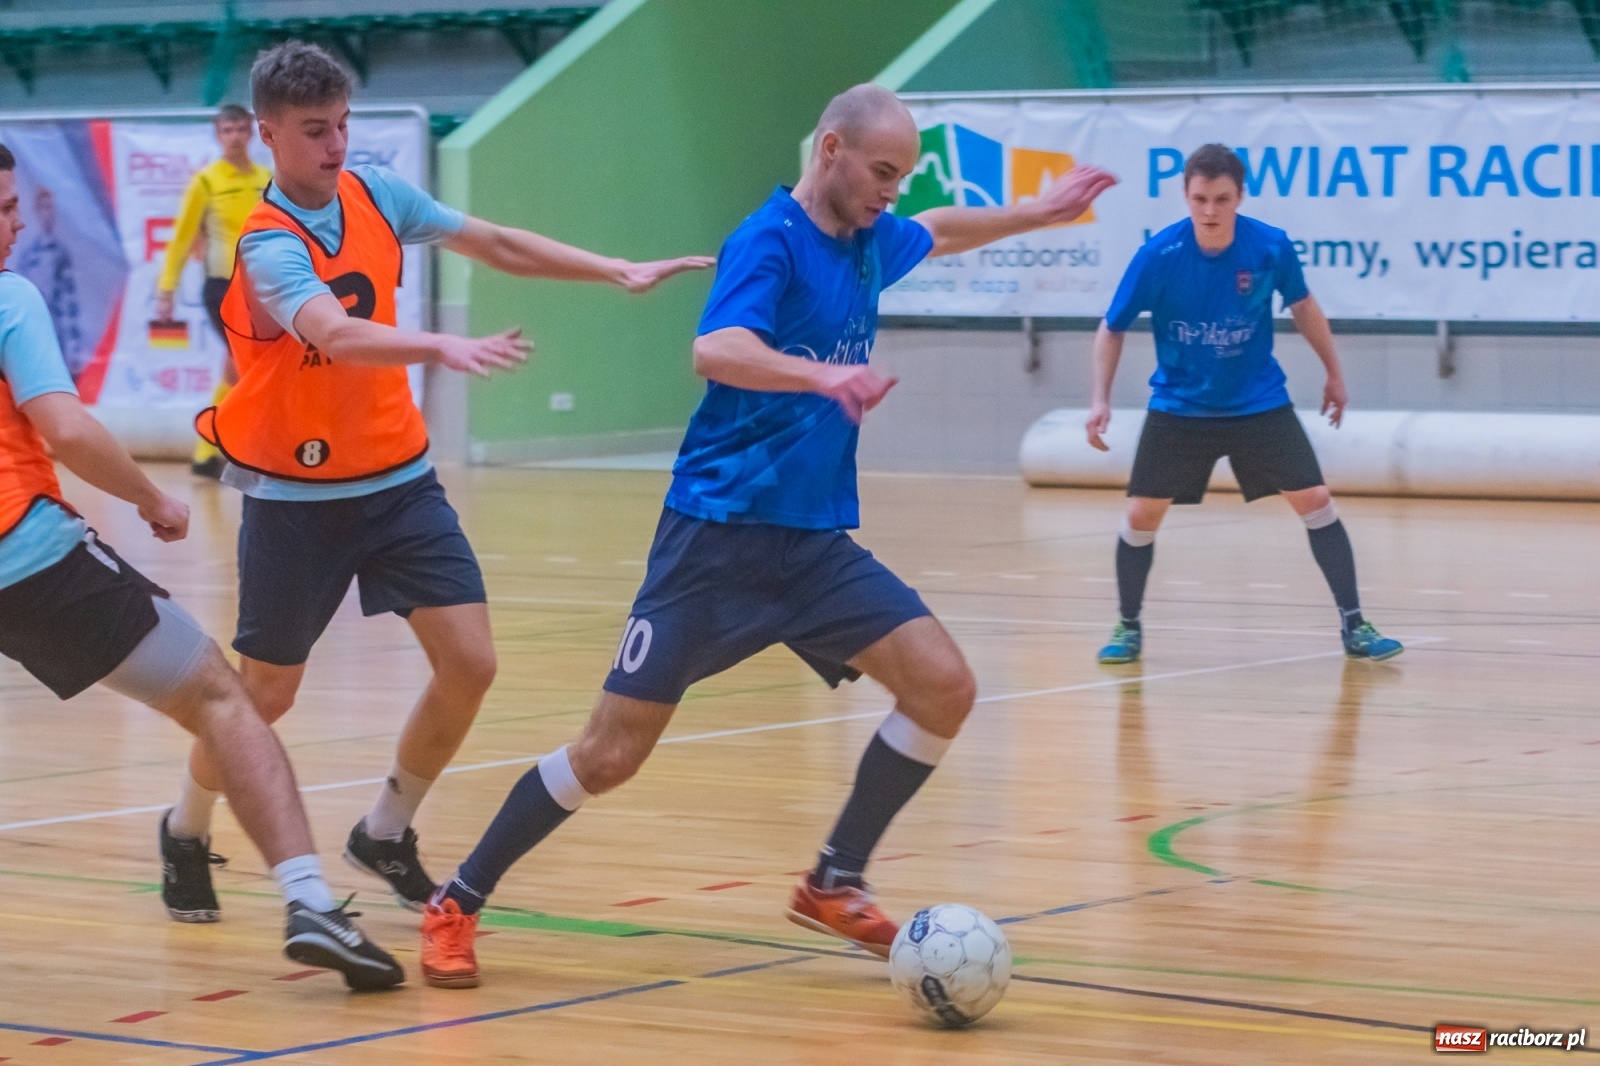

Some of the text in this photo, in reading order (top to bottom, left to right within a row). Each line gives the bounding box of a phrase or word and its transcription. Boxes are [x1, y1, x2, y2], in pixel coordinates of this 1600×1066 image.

[1149, 146, 1408, 198] PWIAT
[1415, 230, 1598, 280] wspiera
[302, 440, 322, 466] 8
[613, 616, 653, 673] 10
